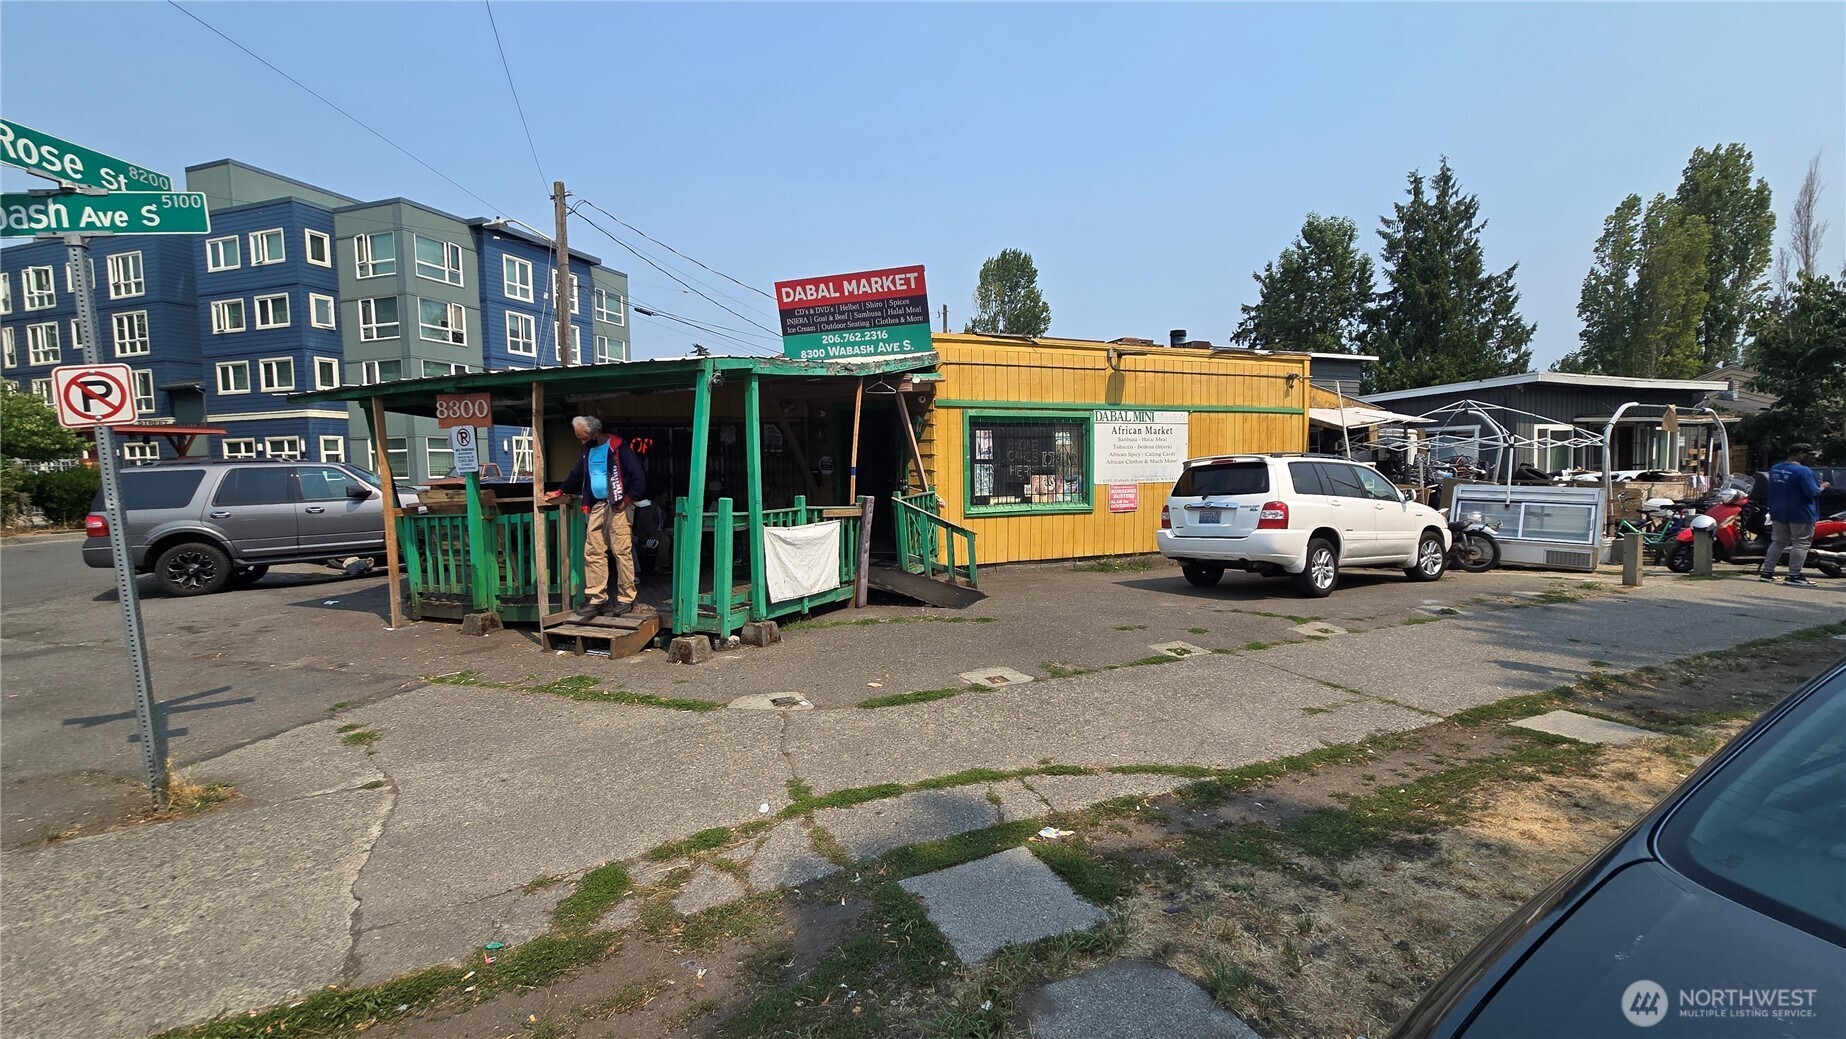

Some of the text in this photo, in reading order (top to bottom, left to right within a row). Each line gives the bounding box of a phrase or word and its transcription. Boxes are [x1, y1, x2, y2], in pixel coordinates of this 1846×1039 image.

[0, 123, 169, 191] Rose St 8200
[79, 206, 129, 228] Ave
[141, 204, 161, 227] S
[161, 195, 202, 209] 5100
[781, 272, 918, 303] DABAL MARKET
[786, 317, 809, 326] INJERA
[813, 315, 828, 323] Goat
[854, 311, 882, 319] Sambusa
[888, 307, 906, 315] Halal
[906, 306, 922, 314] Meat
[815, 306, 834, 314] DVD's
[840, 304, 860, 312] Helbet
[865, 301, 883, 309] Shiro
[889, 299, 910, 307] Spices
[787, 326, 797, 334] Ice
[797, 325, 816, 333] Cream
[821, 323, 847, 331] Outdoor
[847, 320, 870, 329] Seating
[875, 317, 899, 326] Clothes
[906, 315, 924, 323] More
[822, 330, 889, 345] 206.762.2316
[801, 348, 826, 359] 8300
[827, 344, 875, 357] WABASH
[903, 339, 915, 351] S.
[436, 400, 489, 419] 8300
[1095, 411, 1132, 422] DABAL
[1133, 412, 1155, 423] MINI
[1111, 426, 1173, 435] African Market
